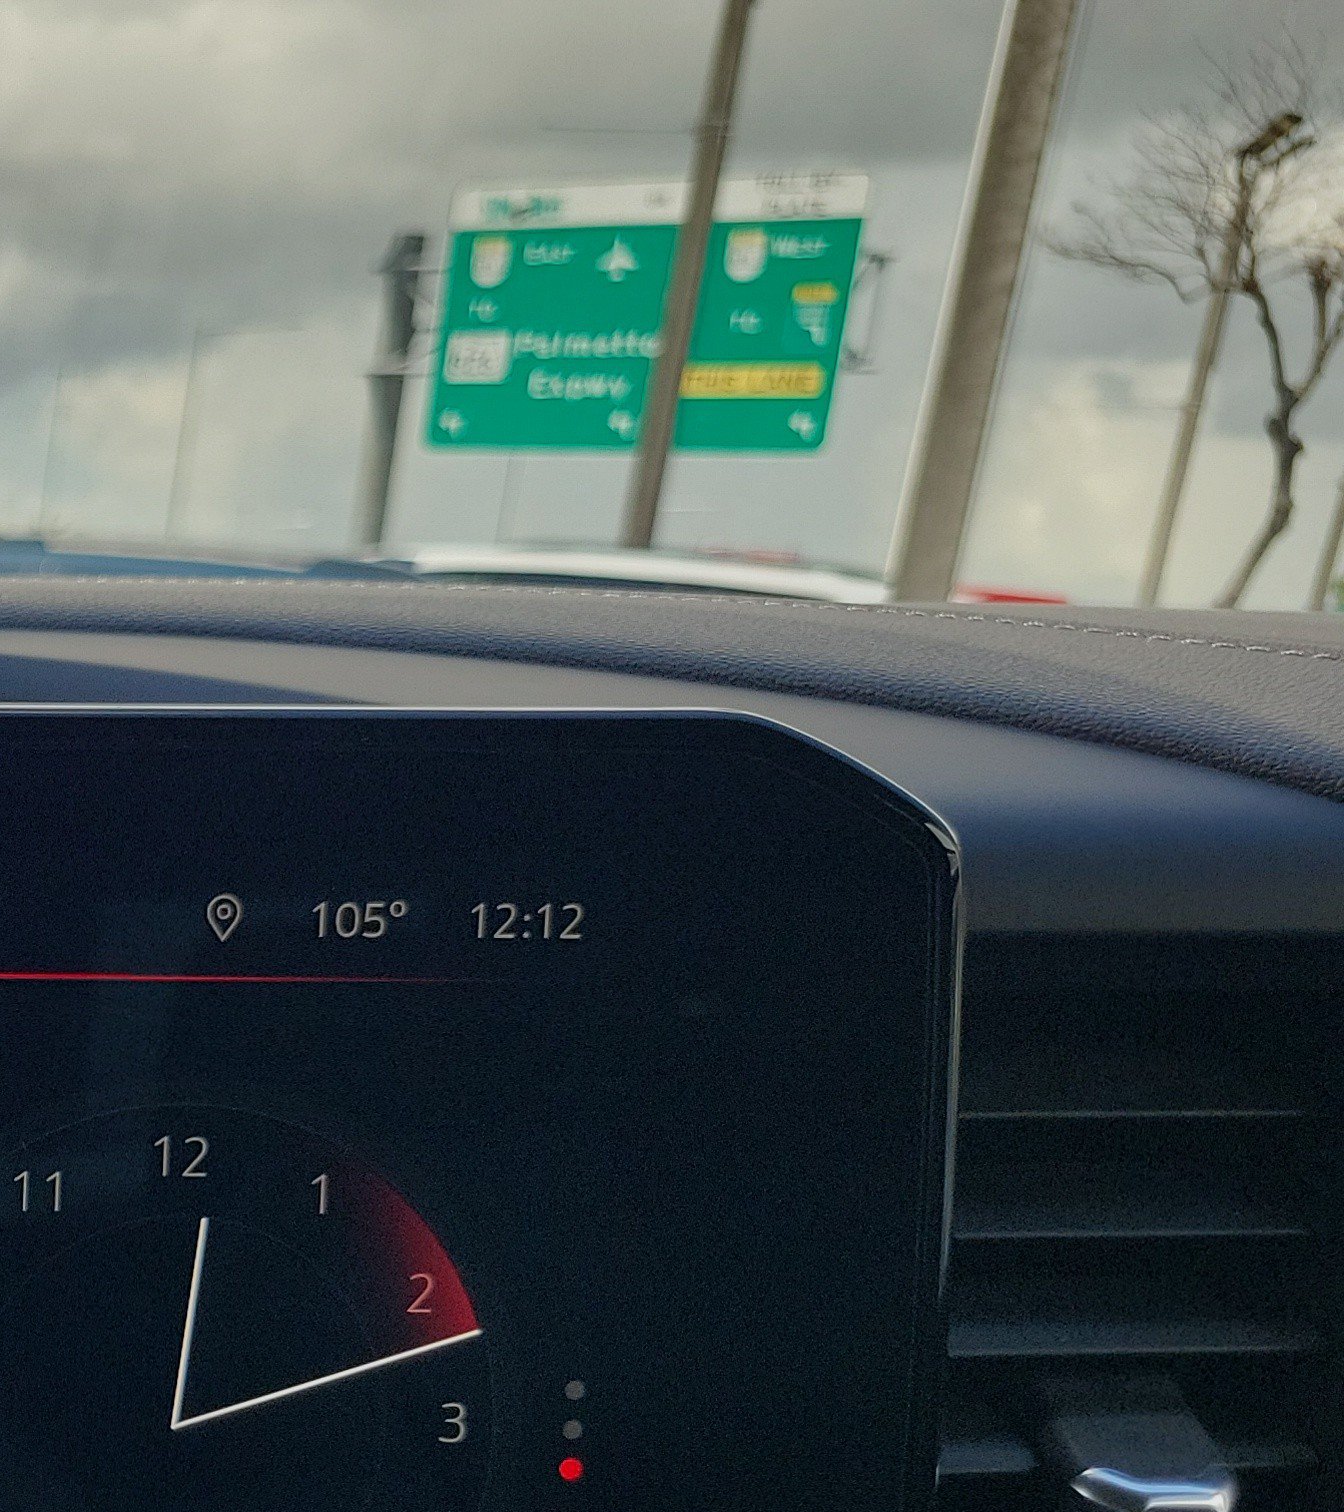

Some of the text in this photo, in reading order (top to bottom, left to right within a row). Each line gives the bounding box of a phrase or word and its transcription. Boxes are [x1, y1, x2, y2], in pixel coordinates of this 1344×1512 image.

[470, 901, 586, 939] 12:12
[153, 1135, 210, 1178] 12
[13, 1169, 63, 1212] 11
[311, 1173, 331, 1215] 1
[406, 1272, 434, 1313] 2
[438, 1402, 466, 1443] 3
